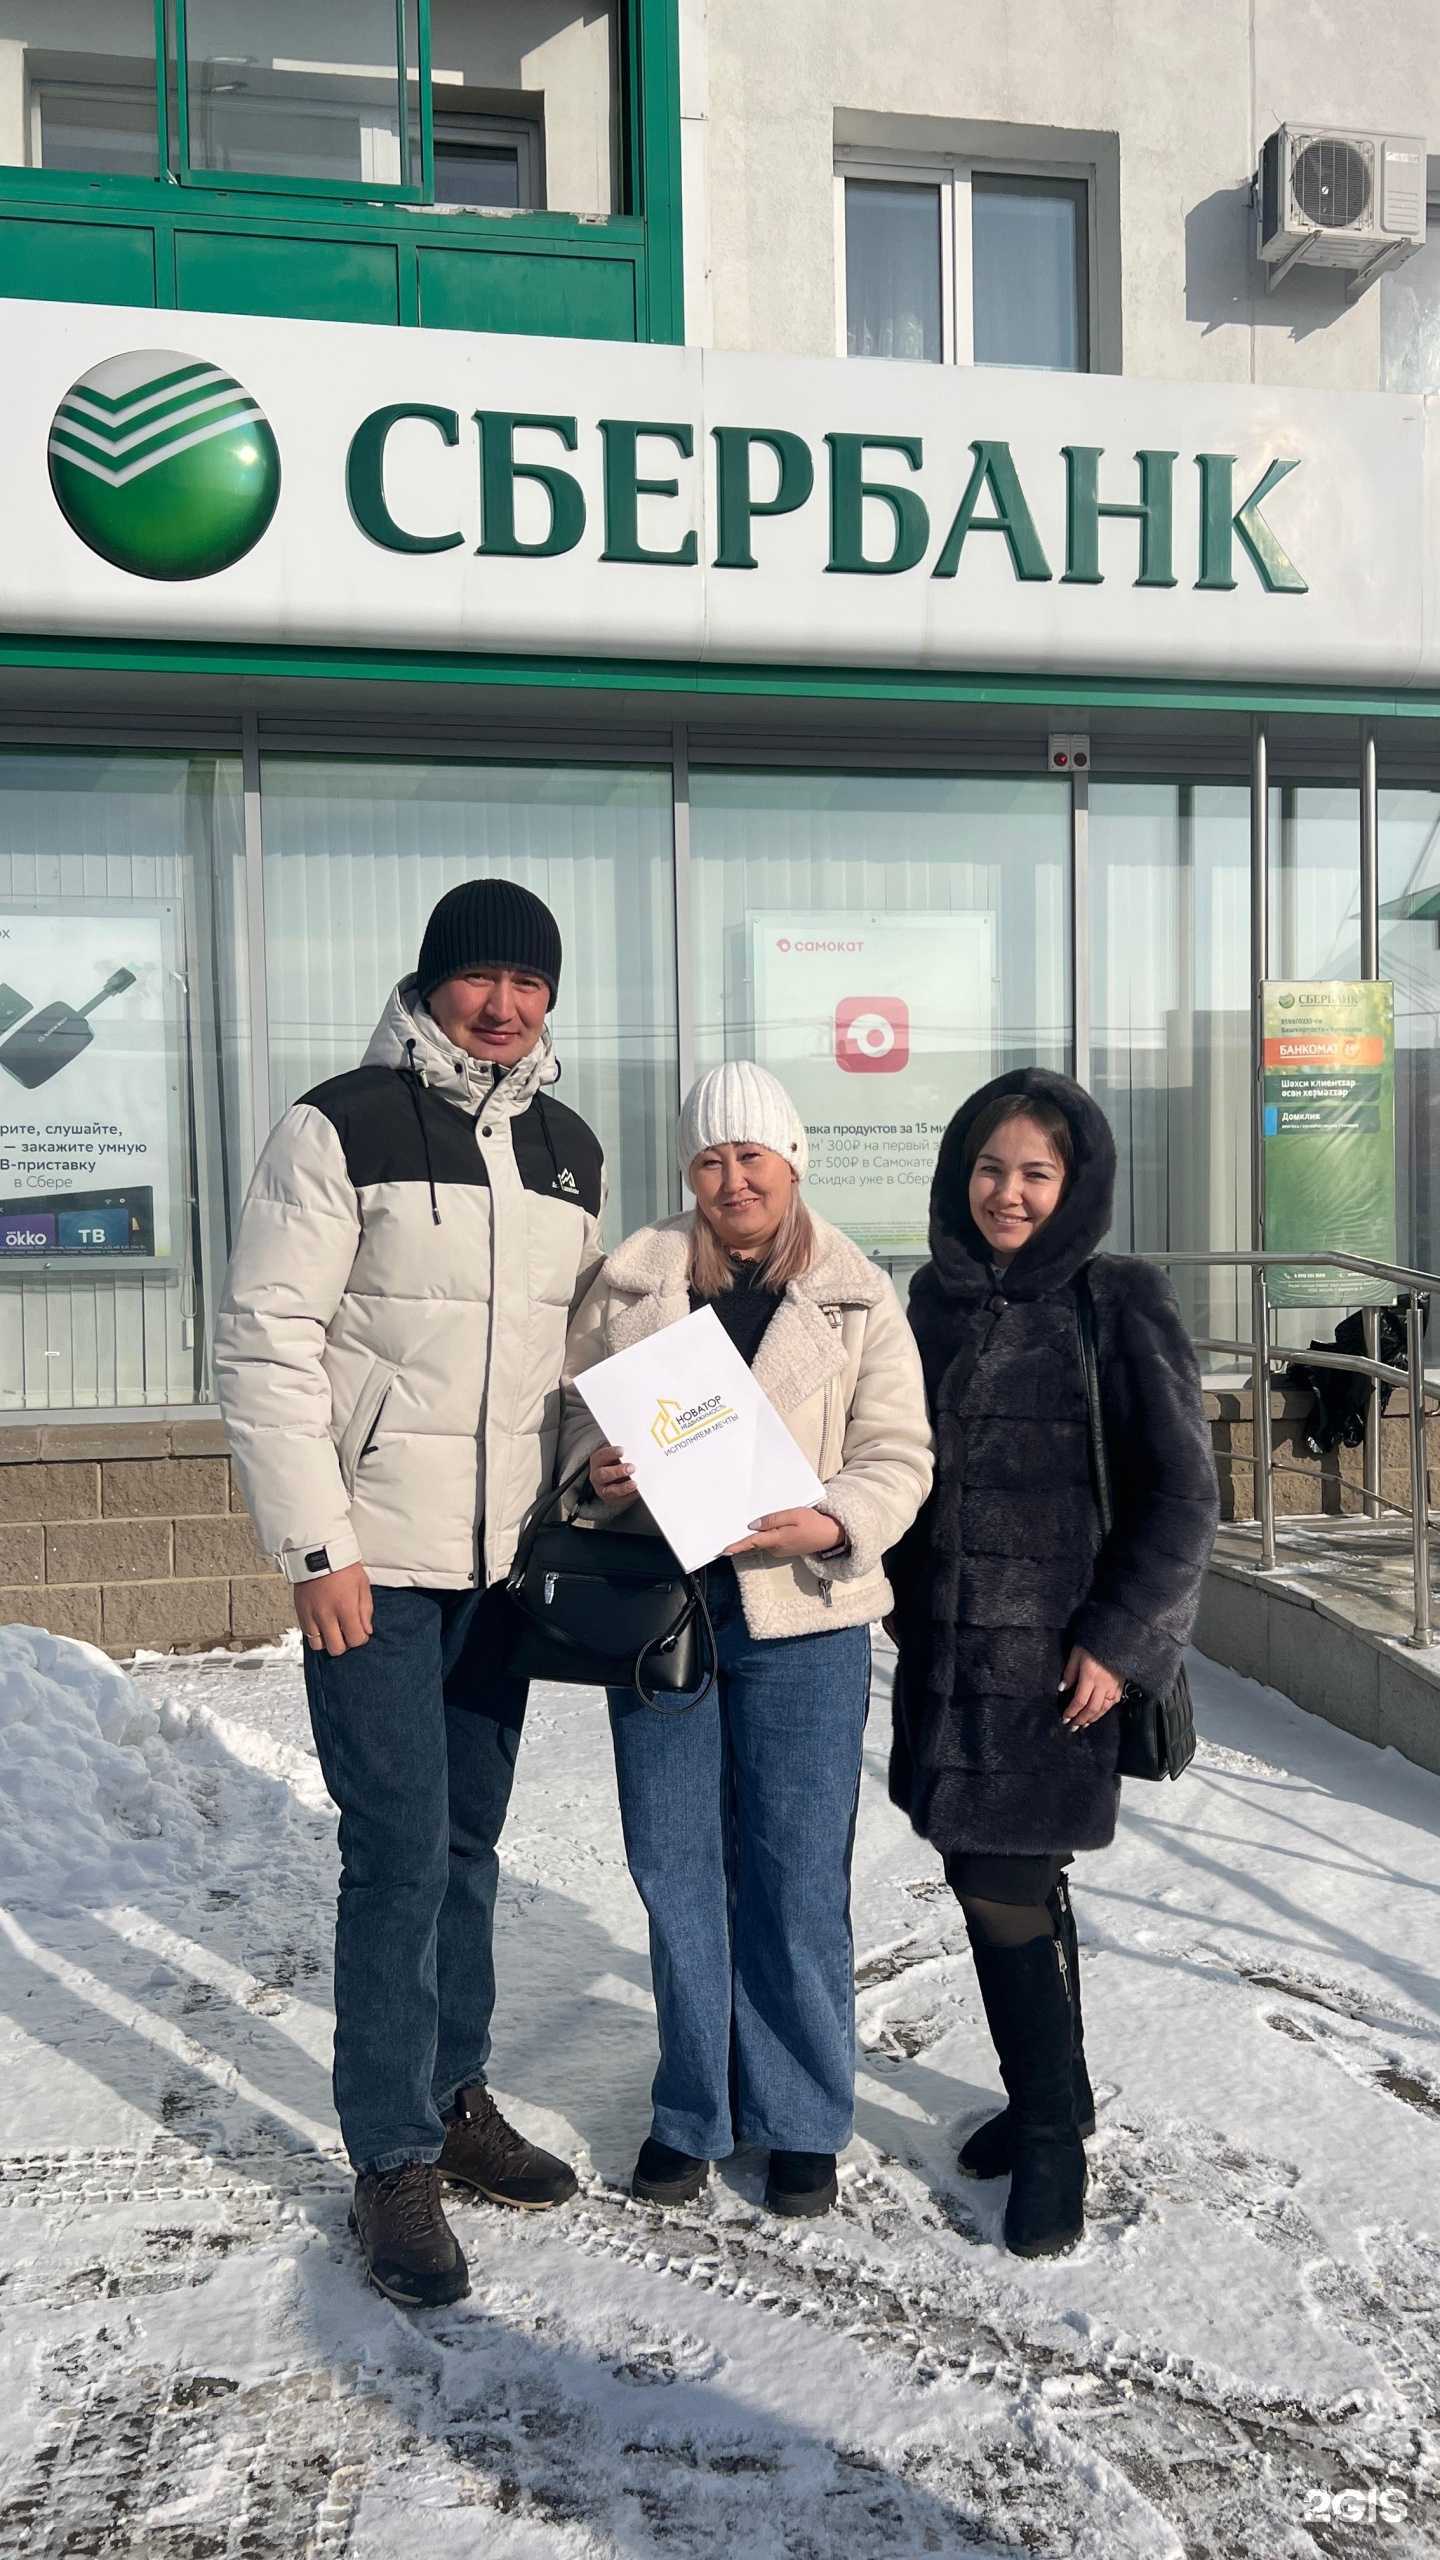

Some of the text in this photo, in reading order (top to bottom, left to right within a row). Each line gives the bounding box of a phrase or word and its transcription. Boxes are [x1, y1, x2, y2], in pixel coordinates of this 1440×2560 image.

[346, 402, 1308, 593] СБЕРБАНК
[795, 941, 864, 952] самокат
[45, 1122, 123, 1137] слушайте,
[833, 1124, 897, 1137] продуктов
[899, 1125, 913, 1134] за
[916, 1122, 928, 1134] 15
[21, 1143, 94, 1153] закажите
[98, 1143, 147, 1155] умную
[864, 1141, 879, 1151] на
[883, 1139, 929, 1153] первый
[0, 1158, 96, 1173] В-приставку
[808, 1160, 823, 1168] от
[862, 1159, 870, 1168] в
[873, 1156, 934, 1168] Самокате
[14, 1174, 73, 1190] в Сбере
[808, 1172, 856, 1186] Скидка
[859, 1175, 884, 1187] уже
[887, 1175, 894, 1184] в
[78, 1228, 106, 1244] ТВ
[675, 1395, 721, 1424] НОВАТОР
[664, 1412, 739, 1457] ИСПОЛНЯЕМ МЕЧТЫ
